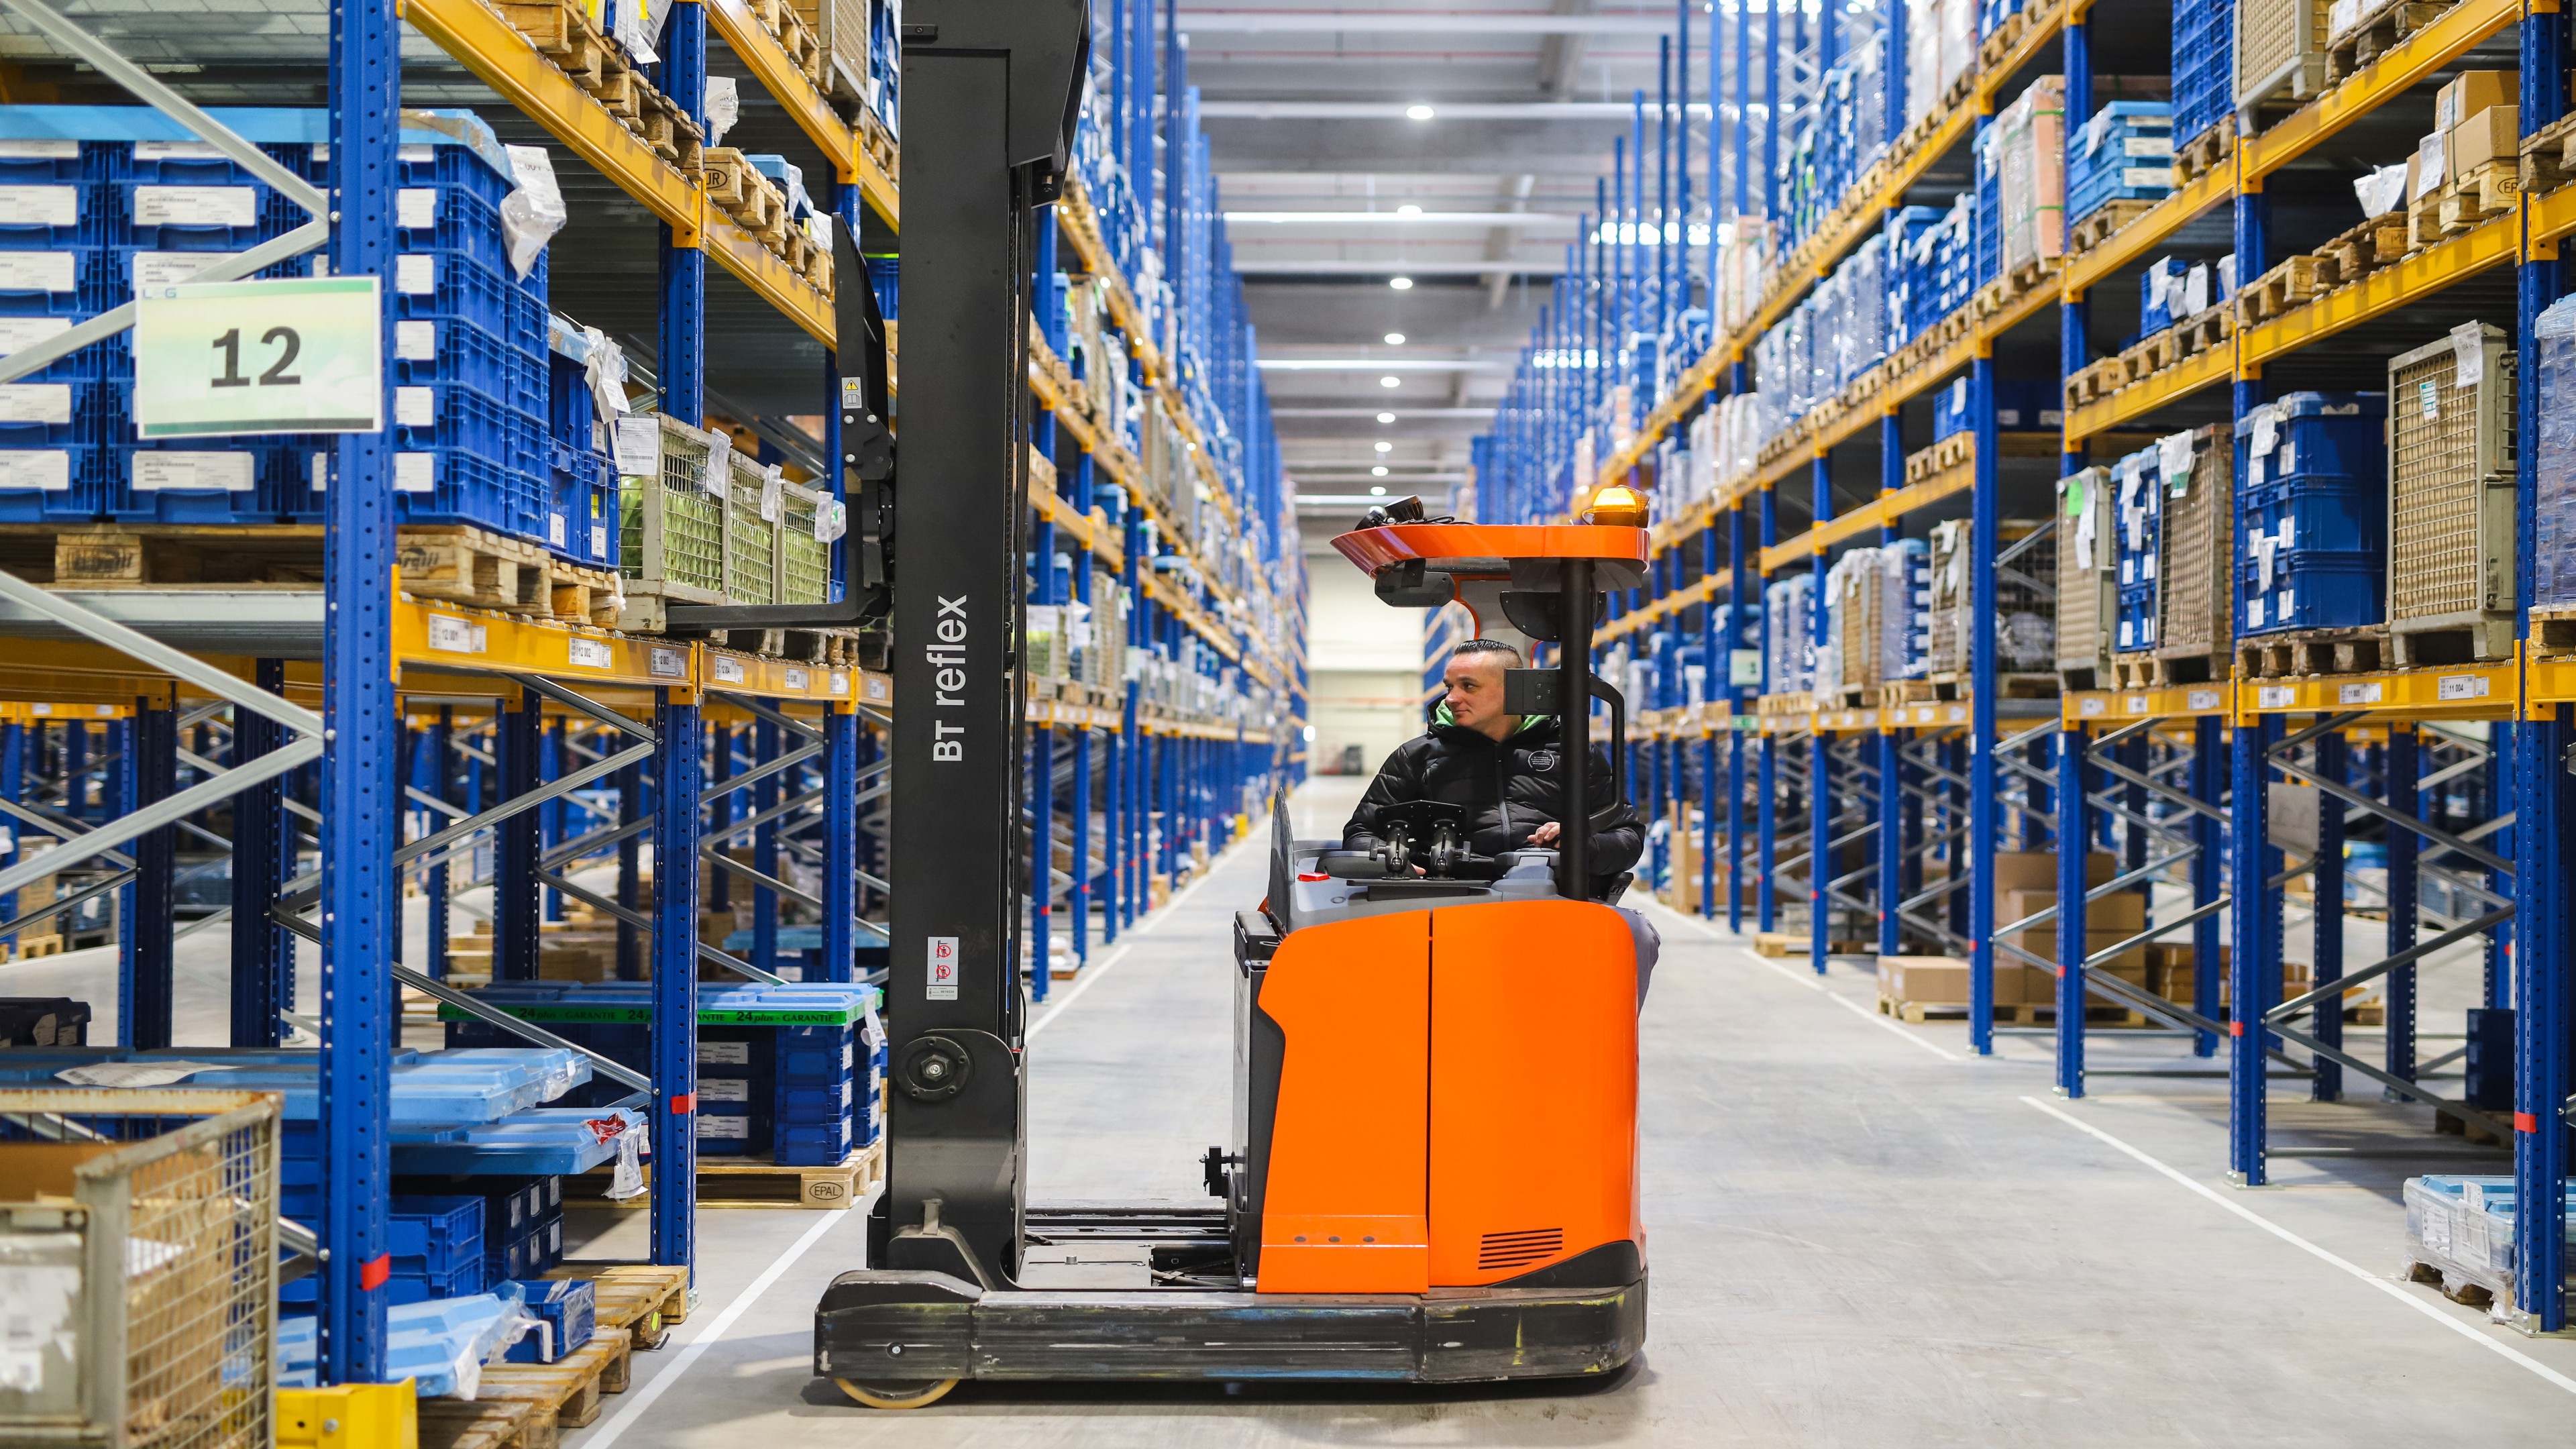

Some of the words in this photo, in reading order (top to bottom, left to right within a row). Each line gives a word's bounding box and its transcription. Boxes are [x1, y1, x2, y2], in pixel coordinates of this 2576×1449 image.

[706, 172, 720, 185] UR
[2504, 181, 2518, 193] EP
[211, 325, 301, 388] 12
[578, 646, 584, 657] 12
[926, 594, 967, 706] reflex
[2449, 684, 2455, 693] 11
[2455, 684, 2463, 692] 004
[932, 719, 965, 761] BT
[519, 1008, 535, 1018] 24
[537, 1010, 556, 1019] plus
[565, 1012, 616, 1020] GARANTIE
[627, 1009, 644, 1020] 24
[697, 1013, 724, 1022] ANTIE
[737, 1011, 753, 1021] 24
[753, 1013, 773, 1023] plus
[782, 1014, 834, 1022] GARANTIE
[814, 1185, 839, 1197] EPAL
